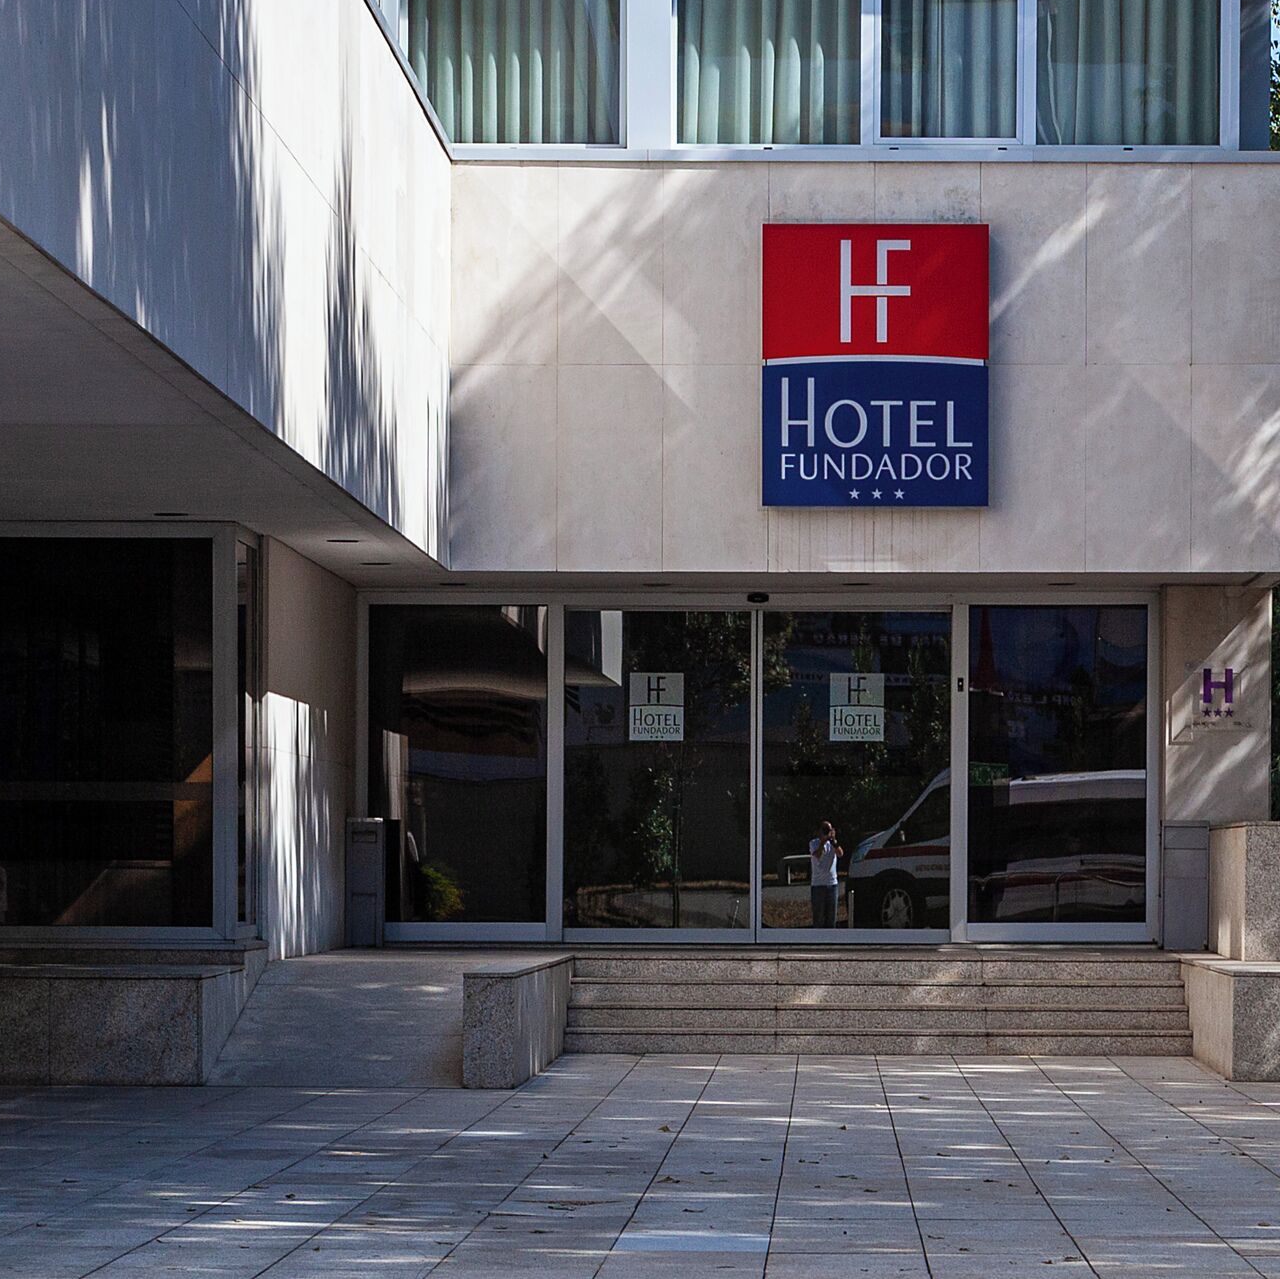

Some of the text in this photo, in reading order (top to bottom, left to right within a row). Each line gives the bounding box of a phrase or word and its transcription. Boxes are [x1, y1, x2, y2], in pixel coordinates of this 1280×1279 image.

[839, 239, 912, 343] HF
[780, 376, 973, 448] HOTEL
[780, 452, 973, 481] FUNDADOR
[646, 676, 666, 704] HF
[847, 676, 867, 704] HF
[1202, 668, 1234, 703] H
[632, 727, 681, 735] FUNDADOR
[633, 708, 680, 726] HOTEL
[833, 708, 881, 727] HOTEL
[833, 727, 881, 736] FUNDADOR
